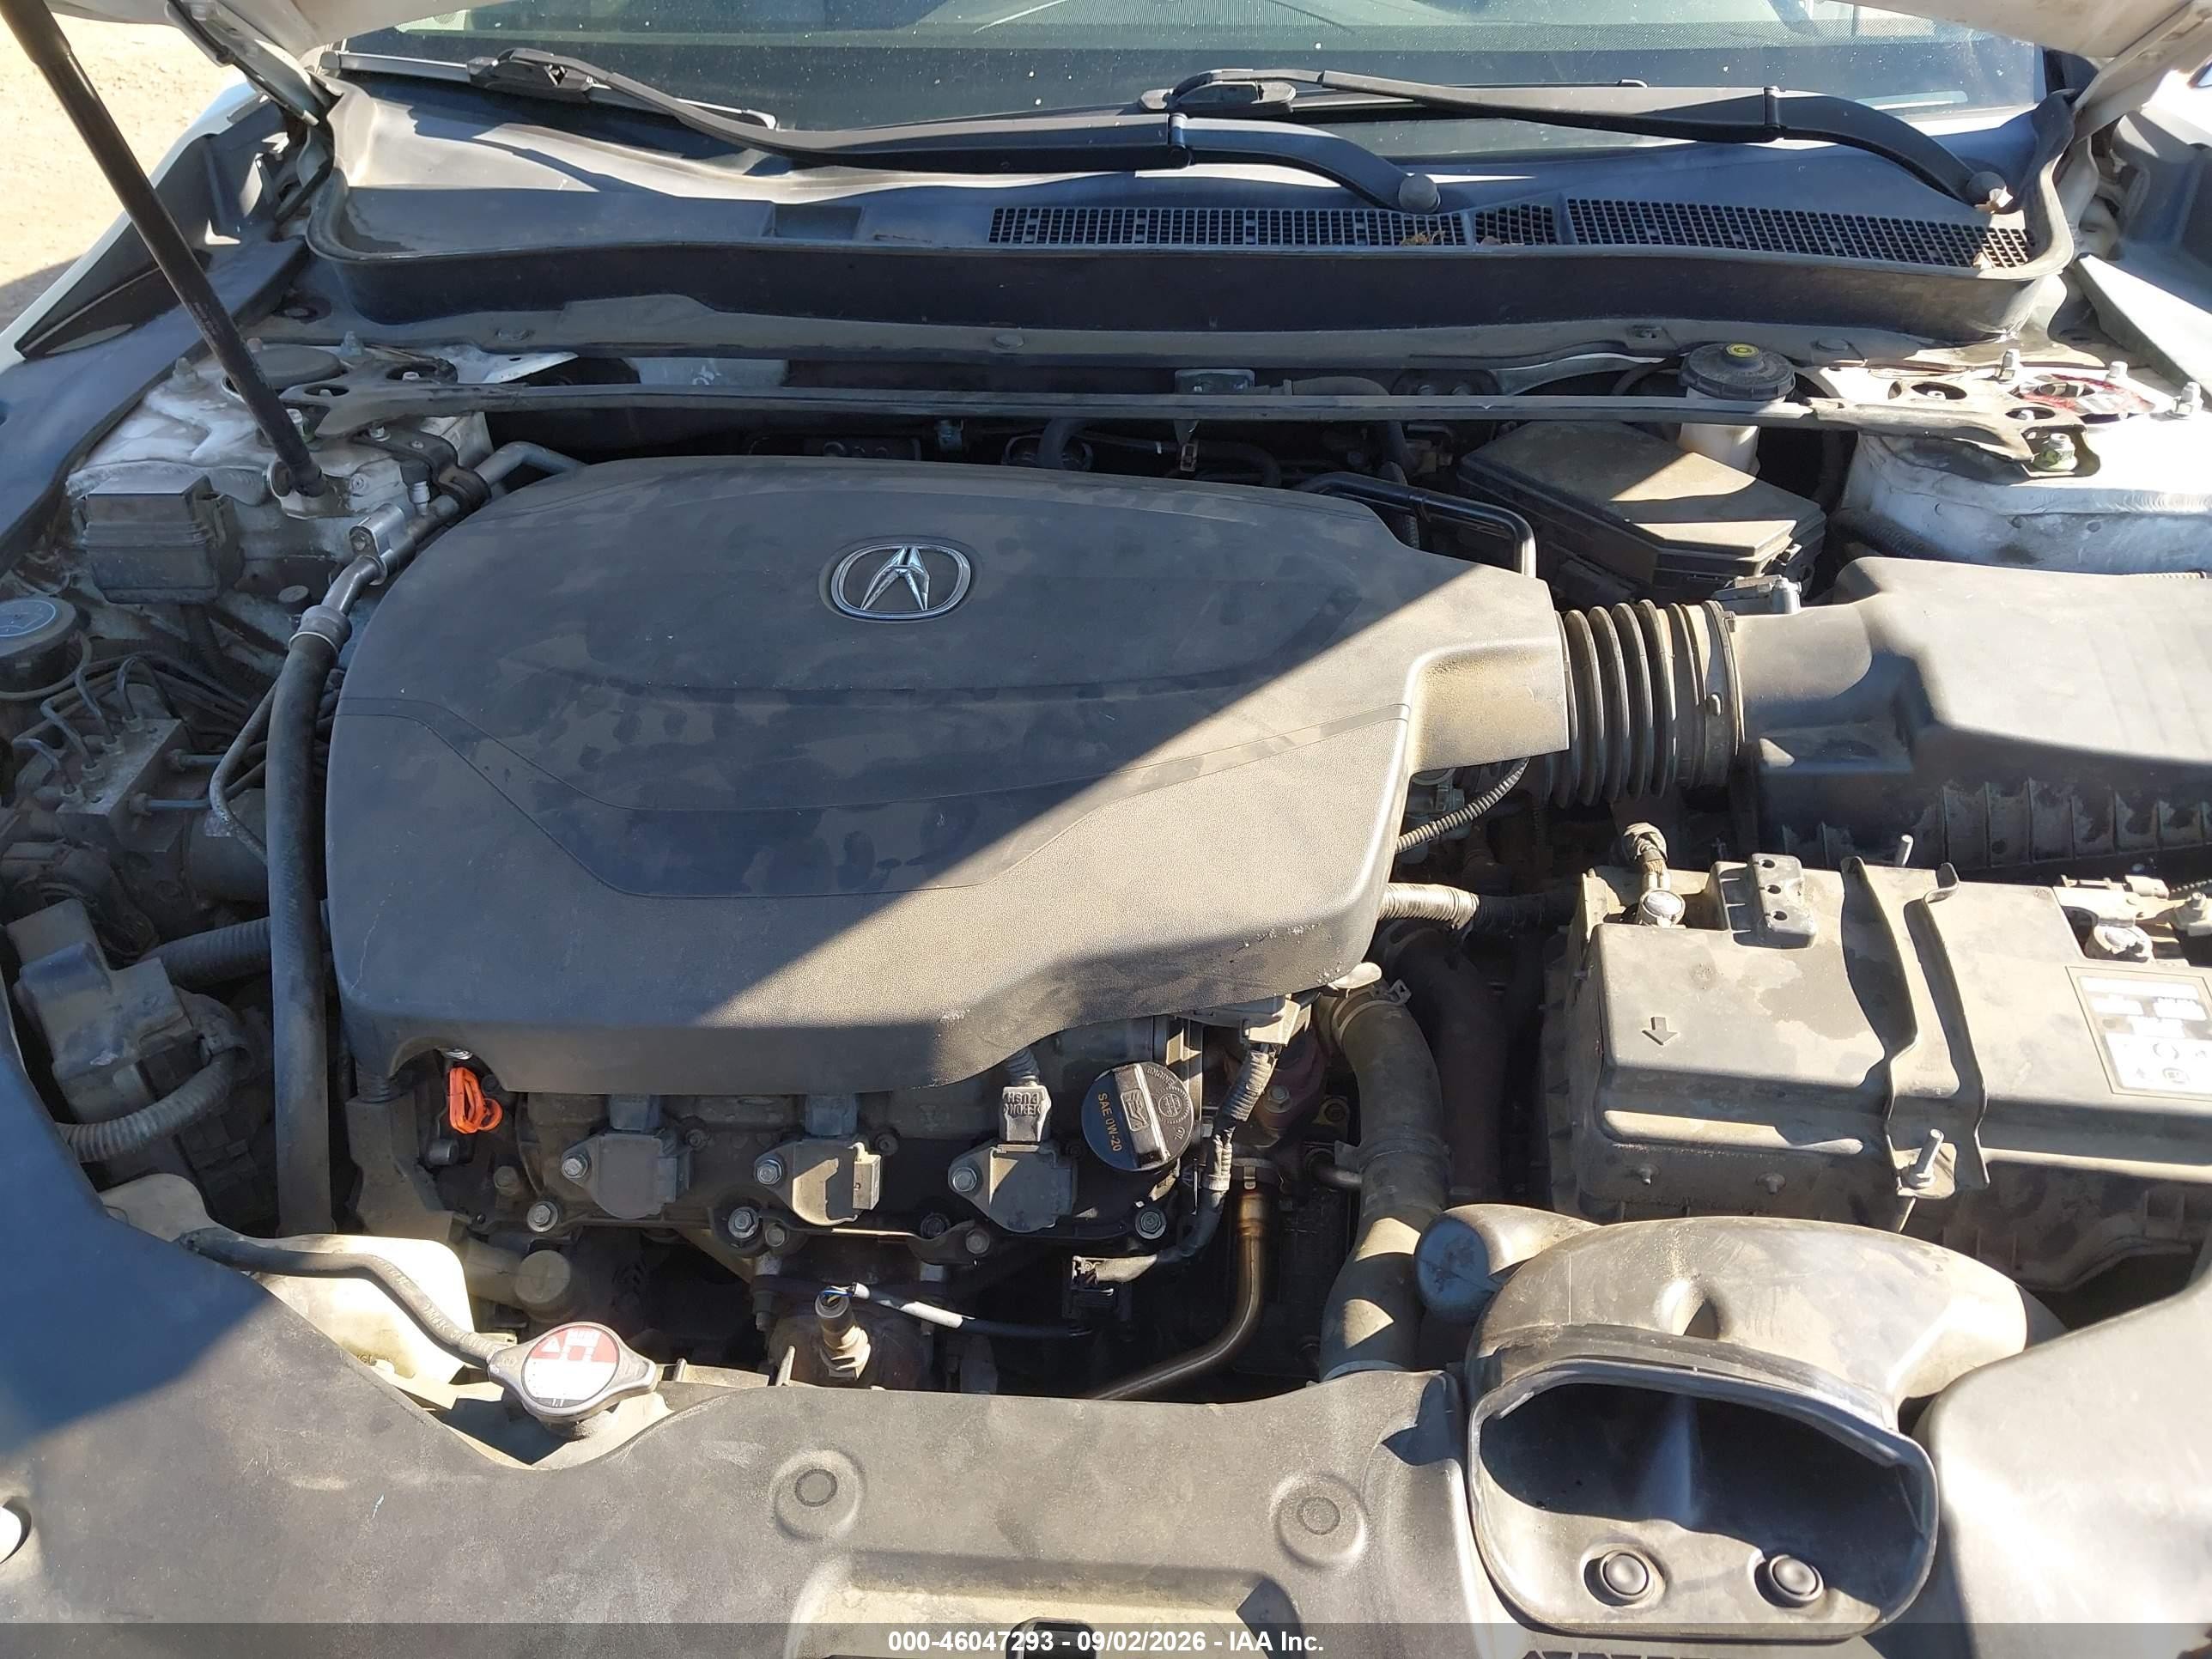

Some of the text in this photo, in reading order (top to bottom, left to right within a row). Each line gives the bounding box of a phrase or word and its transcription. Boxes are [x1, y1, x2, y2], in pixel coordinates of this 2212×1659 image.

[1147, 1066, 1176, 1086] ENGINE
[1008, 1091, 1039, 1104] PUSH
[1098, 1092, 1122, 1152] SAE 0W-20
[1174, 1127, 1185, 1140] OIL
